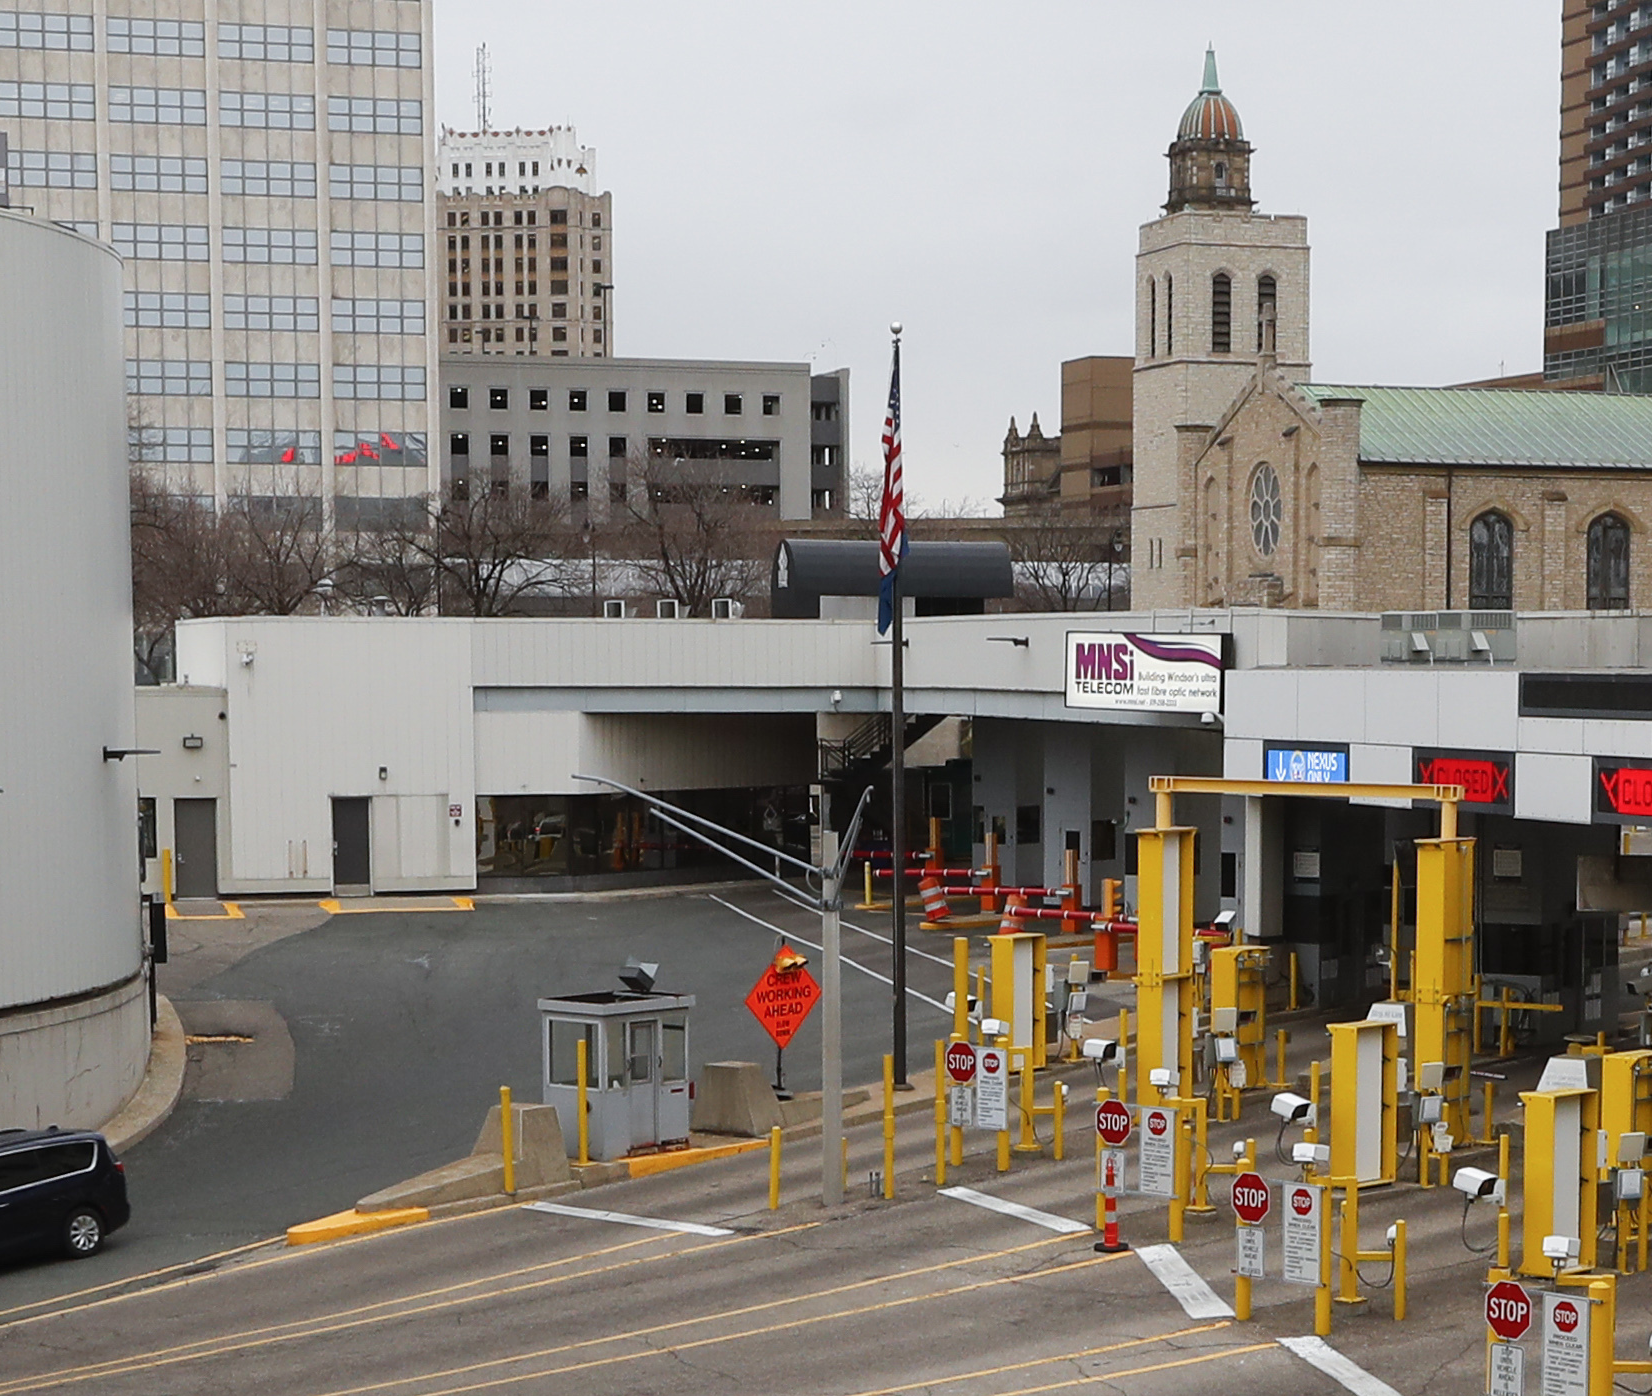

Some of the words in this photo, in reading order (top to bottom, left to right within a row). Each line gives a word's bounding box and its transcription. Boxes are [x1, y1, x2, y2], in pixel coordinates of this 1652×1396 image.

[1075, 643, 1135, 681] MNSi
[1138, 672, 1166, 684] Building
[1167, 672, 1199, 682] Windsor's
[1075, 682, 1134, 694] TELECOM
[1189, 688, 1217, 698] network
[1307, 752, 1338, 771] NEXUS
[766, 970, 802, 988] CREW
[757, 985, 811, 1004] WORKING
[764, 1002, 803, 1018] AHEAD
[949, 1054, 975, 1070] STOP
[984, 1058, 999, 1068] STOP
[1099, 1112, 1128, 1132] STOP
[1149, 1118, 1165, 1129] STOP
[1235, 1187, 1267, 1208] STOP
[1293, 1196, 1311, 1208] STOP
[1489, 1297, 1527, 1322] STOP
[1555, 1308, 1577, 1325] STOP
[1565, 1342, 1583, 1350] CLEAR
[1496, 1364, 1517, 1374] VEHICLE
[1498, 1372, 1515, 1382] AHEAD
